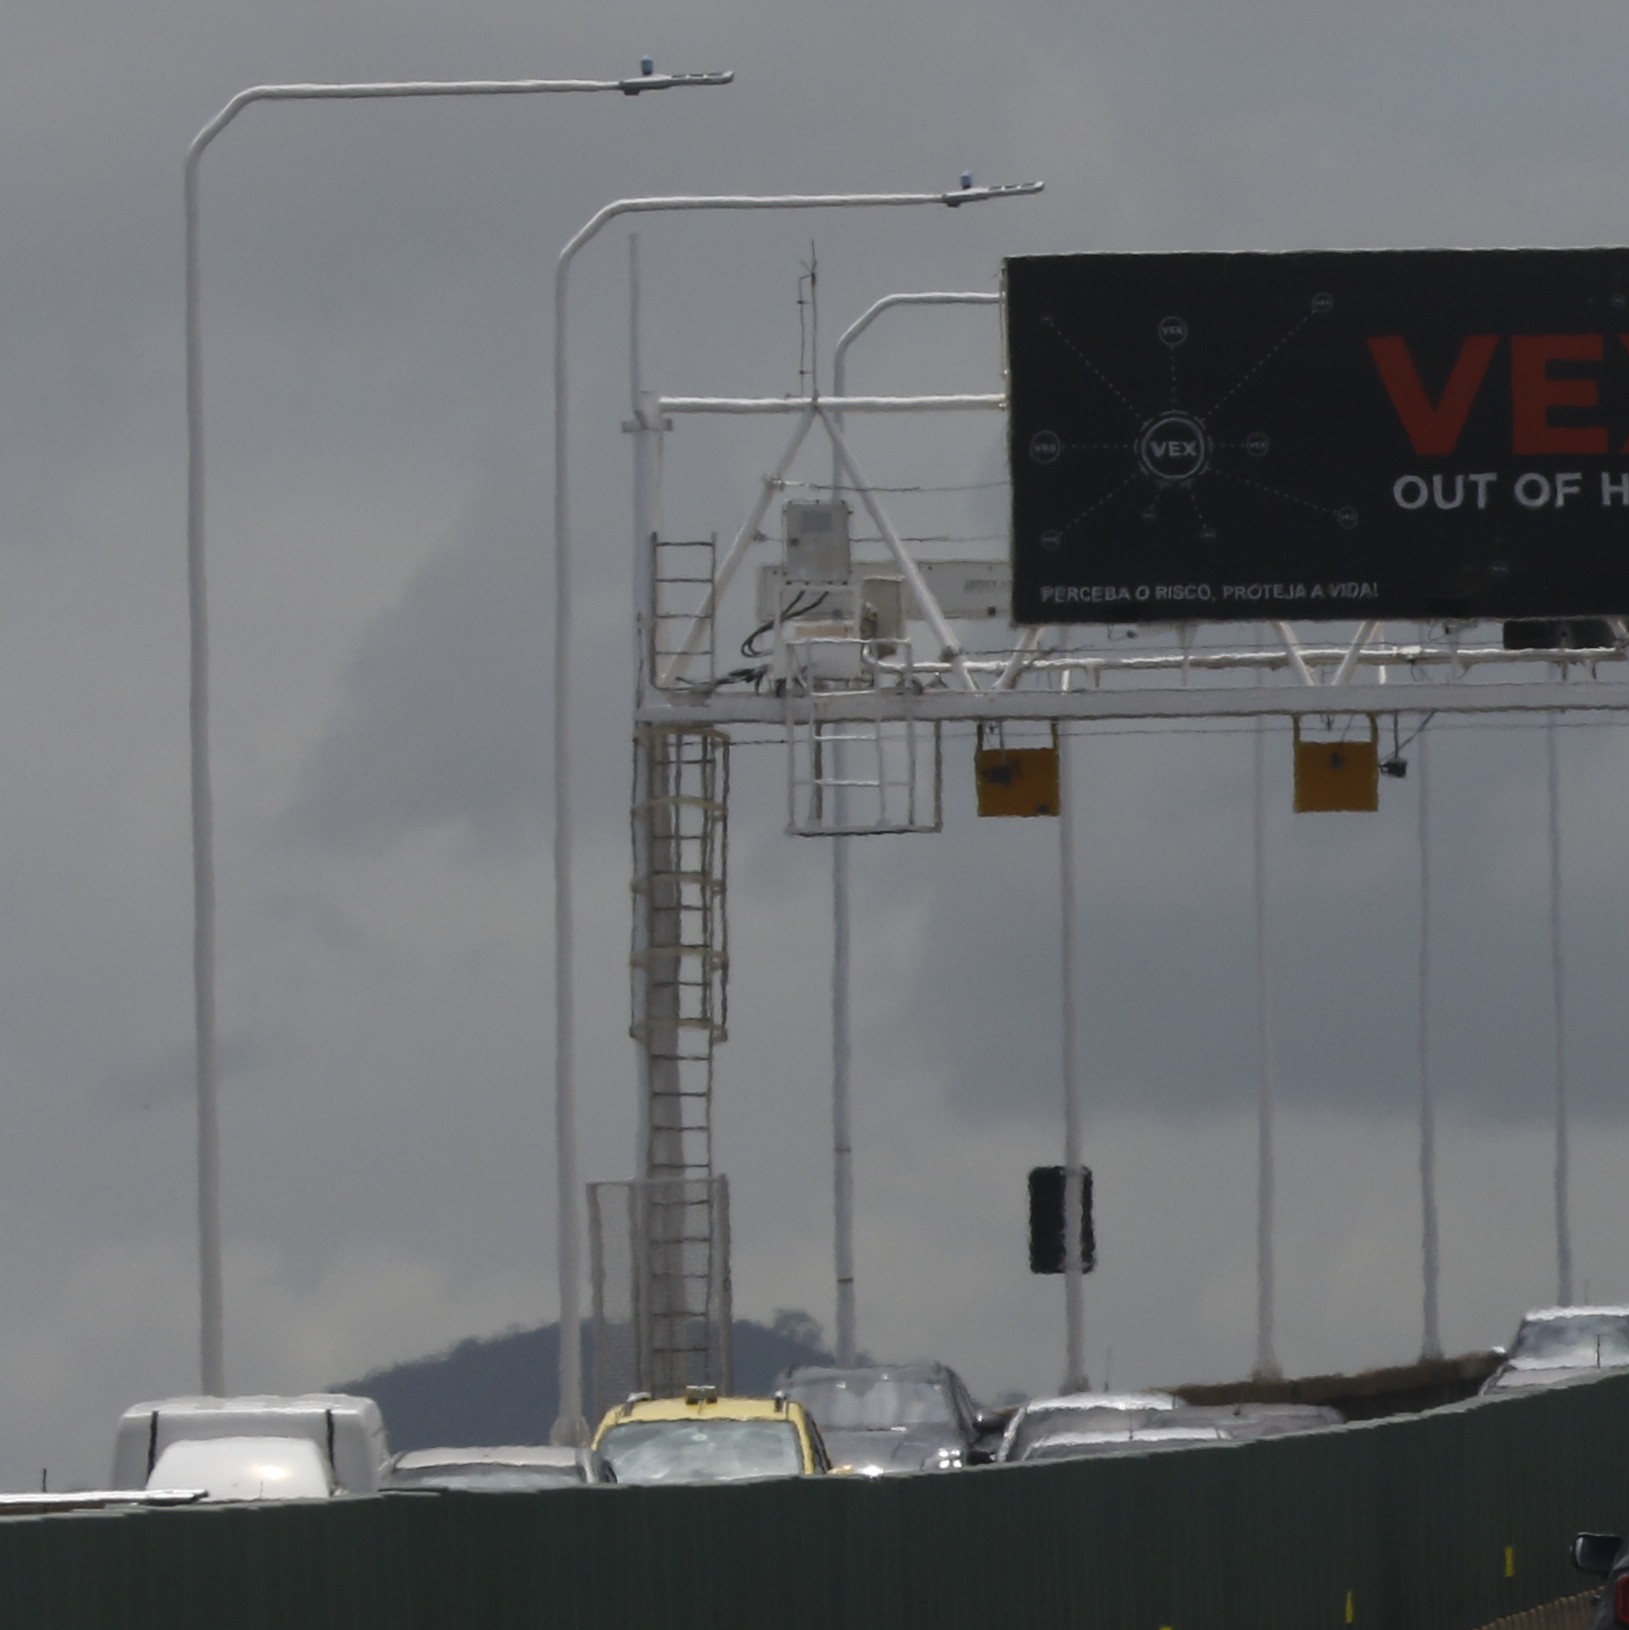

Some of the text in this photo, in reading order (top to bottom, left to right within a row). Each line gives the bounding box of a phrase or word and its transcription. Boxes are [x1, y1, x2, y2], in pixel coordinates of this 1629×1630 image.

[1149, 441, 1198, 457] VEX
[1393, 472, 1498, 511] OUT
[1513, 471, 1583, 509] OF
[1041, 586, 1131, 602] PERCEBA
[1134, 584, 1150, 600] O
[1223, 582, 1303, 600] PROTEJA
[1309, 582, 1326, 599] A
